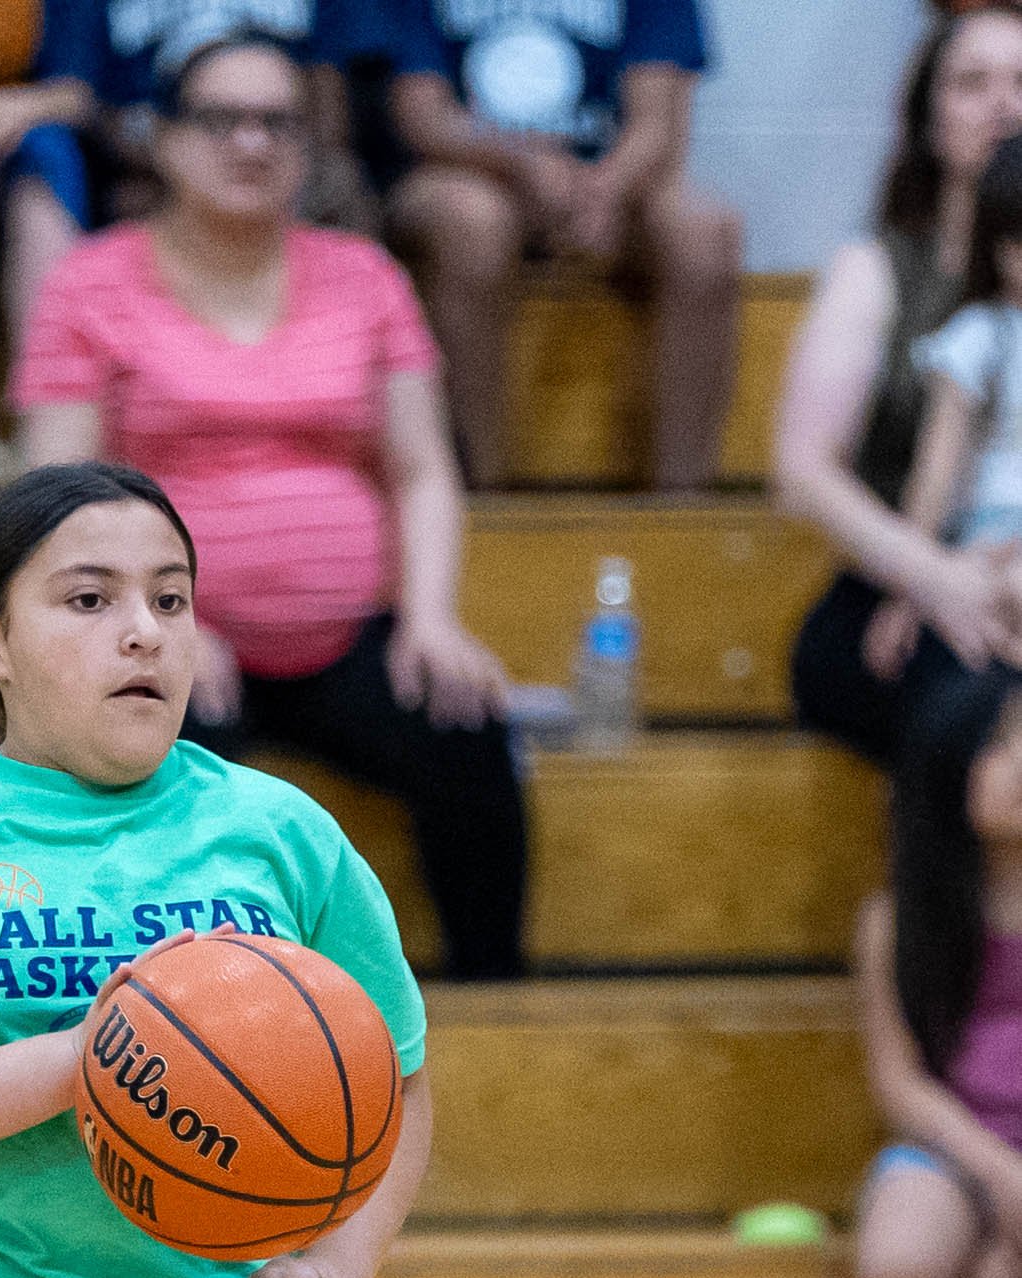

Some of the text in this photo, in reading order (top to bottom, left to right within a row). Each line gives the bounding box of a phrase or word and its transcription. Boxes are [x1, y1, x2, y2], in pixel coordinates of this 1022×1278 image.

[132, 898, 277, 945] STAR
[92, 1002, 241, 1173] Wilson
[98, 1138, 158, 1223] NBA
